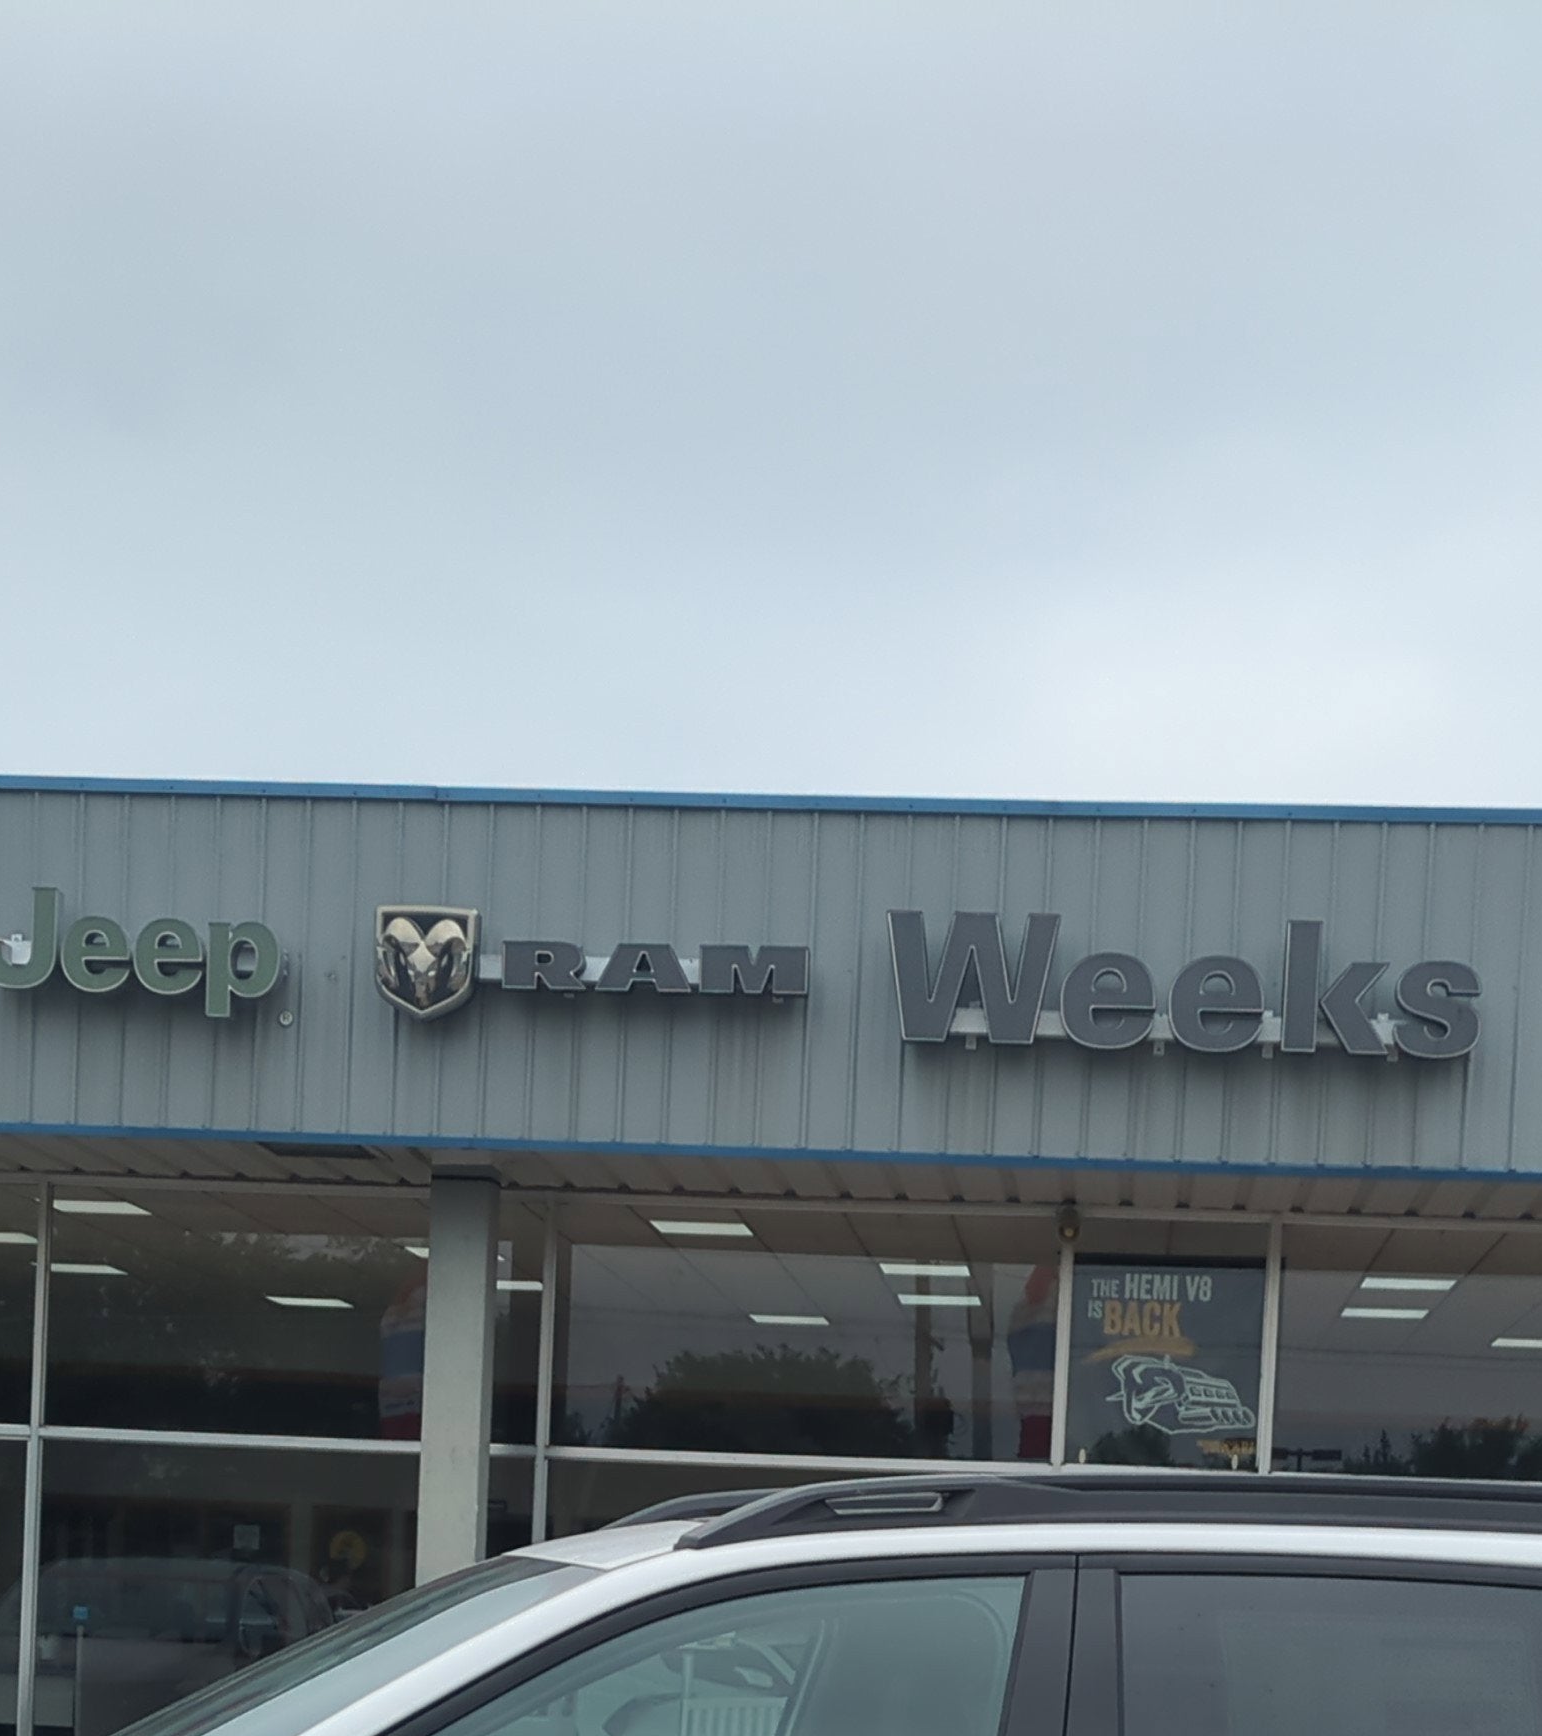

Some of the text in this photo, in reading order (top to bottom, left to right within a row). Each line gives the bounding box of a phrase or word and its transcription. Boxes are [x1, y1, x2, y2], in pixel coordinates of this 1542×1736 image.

[501, 939, 811, 995] RAM
[886, 910, 1483, 1060] Weeks
[1091, 1273, 1213, 1302] THE HEMI V8
[1087, 1300, 1183, 1338] IS BACK
